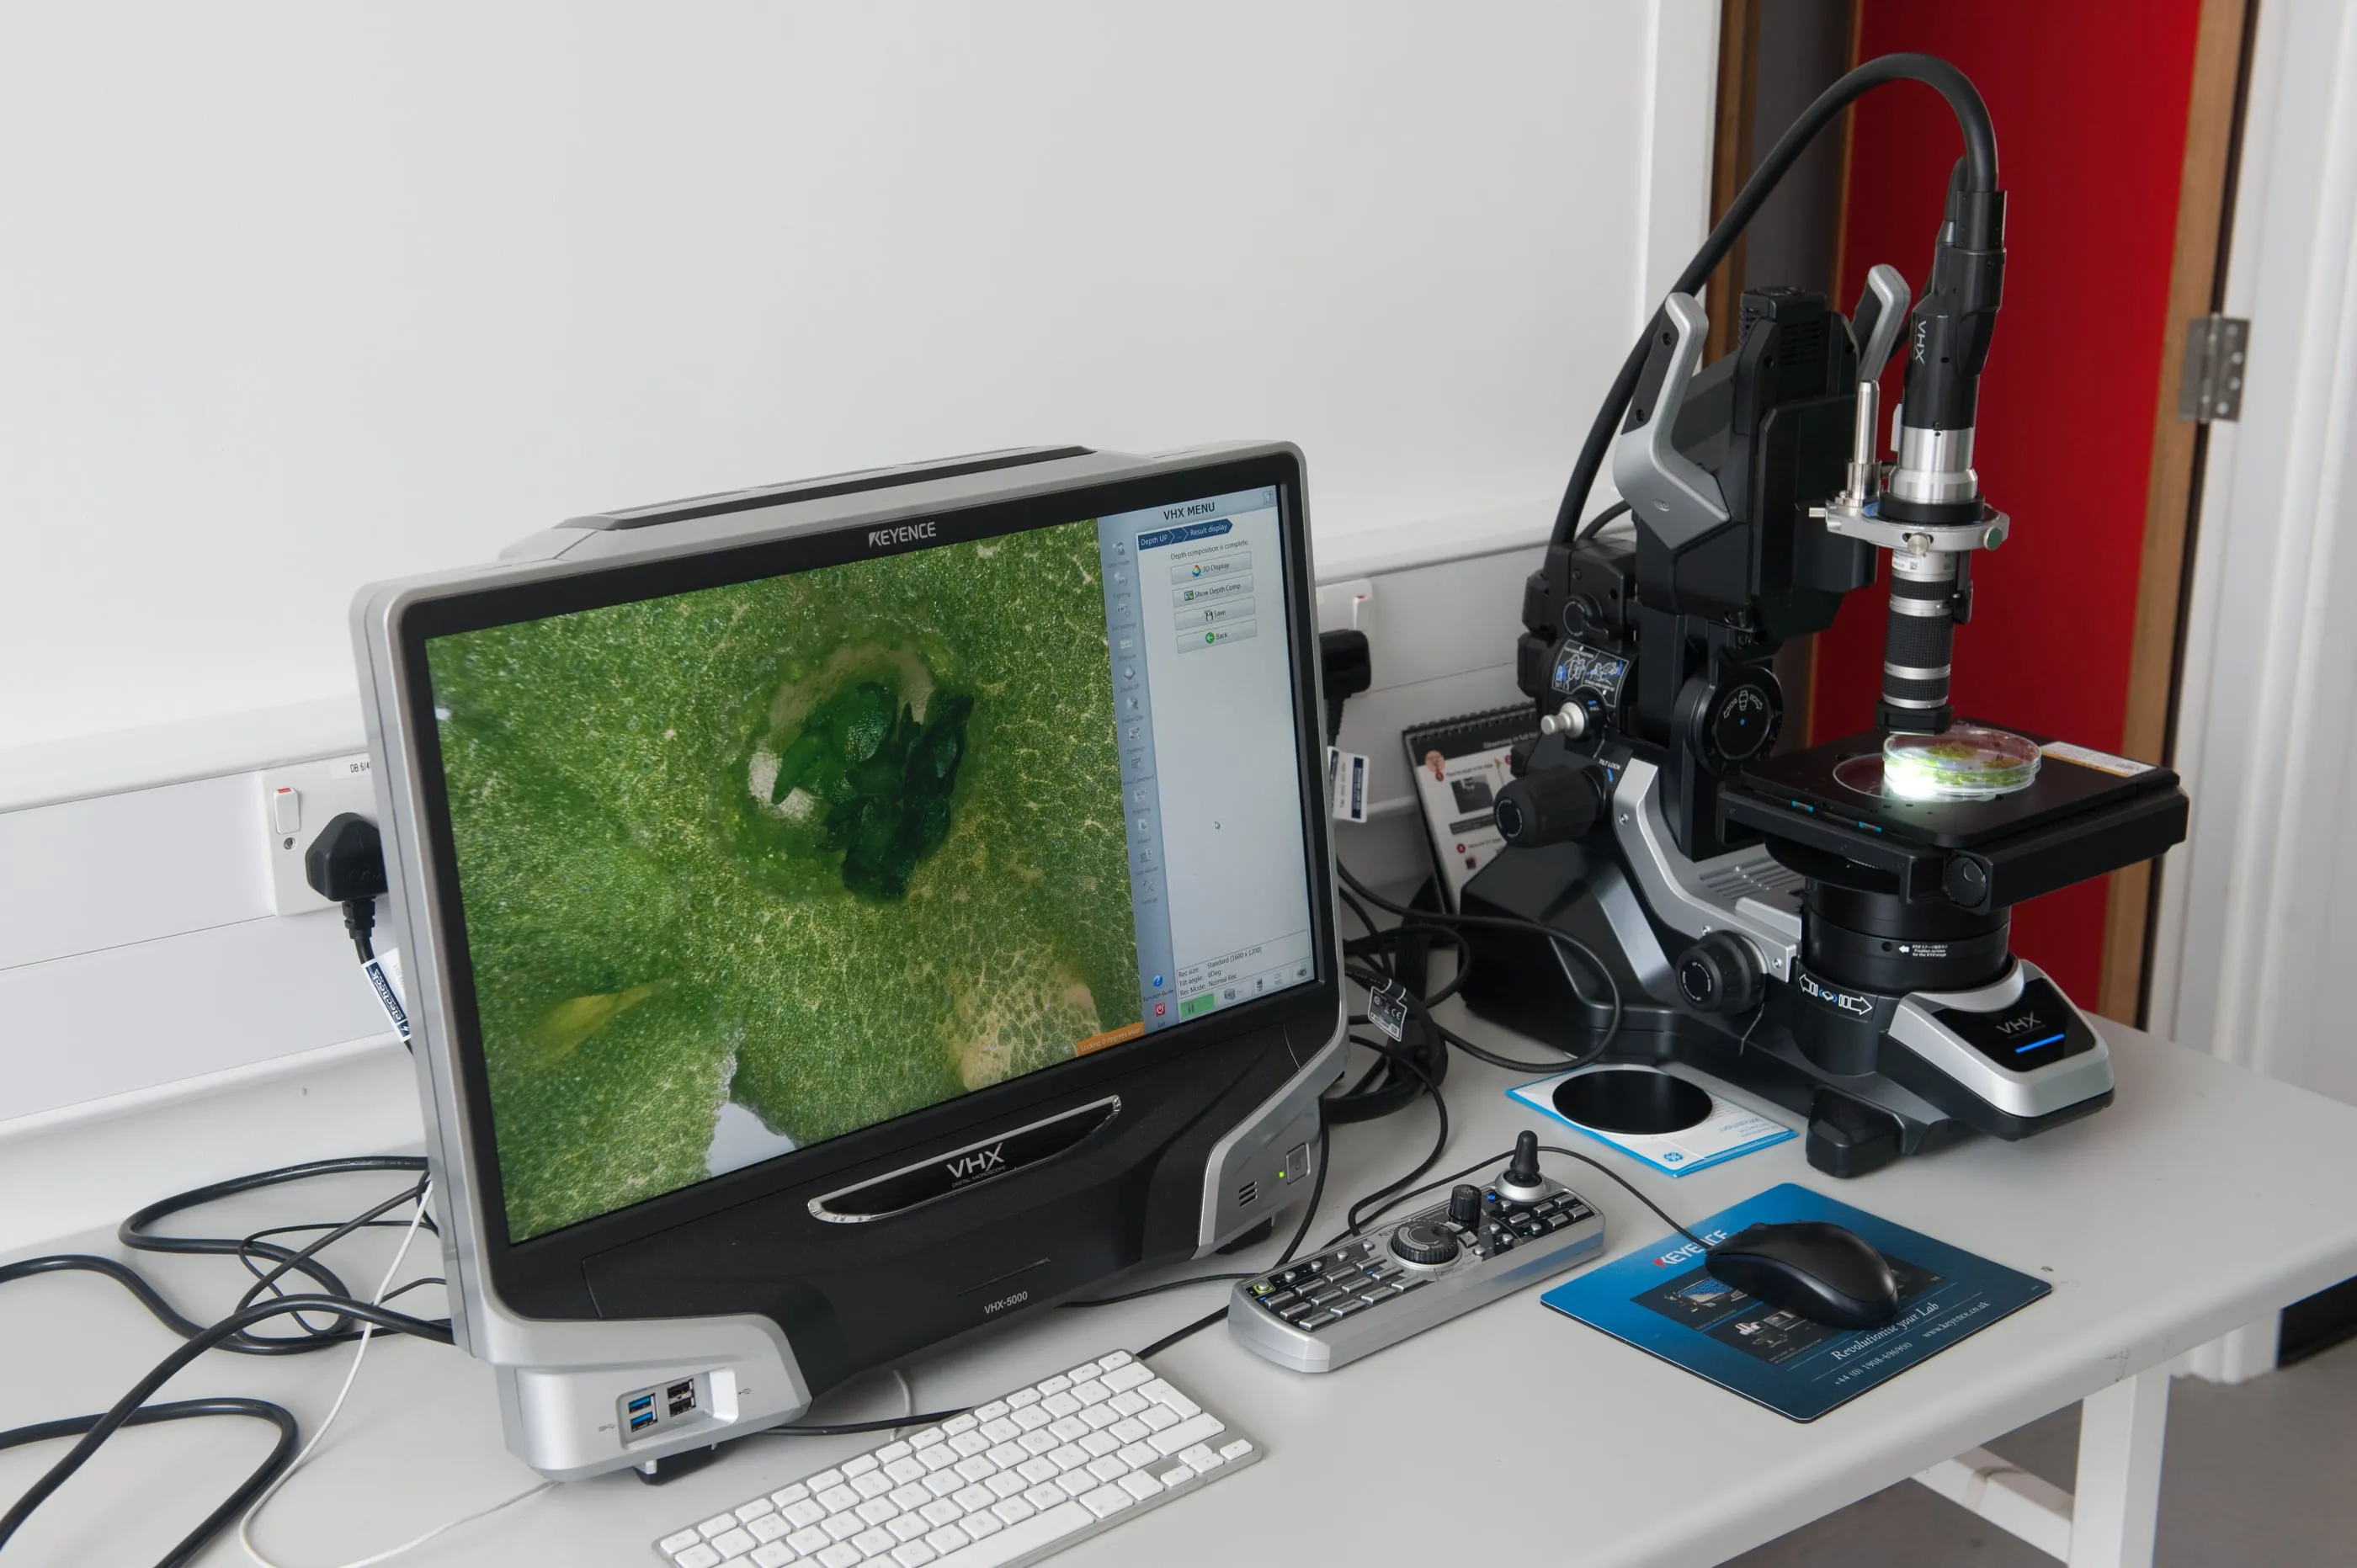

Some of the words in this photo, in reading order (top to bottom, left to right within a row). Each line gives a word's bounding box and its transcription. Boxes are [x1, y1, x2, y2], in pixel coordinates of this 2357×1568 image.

[1914, 321, 1926, 365] VHX
[1163, 508, 1184, 520] VHX
[1187, 502, 1216, 517] MENU
[868, 522, 937, 547] KEYENCE
[1190, 527, 1208, 536] Result
[1209, 523, 1227, 534] display
[1141, 537, 1158, 546] Depth
[1159, 534, 1168, 543] UP
[1170, 551, 1187, 561] Depth
[1187, 544, 1219, 556] composition
[1210, 562, 1230, 571] Display
[1195, 590, 1209, 598] Show
[1209, 587, 1226, 595] Depth
[1226, 583, 1241, 592] Comp
[1214, 609, 1226, 618] Save
[1216, 631, 1228, 640] Back
[350, 763, 359, 773] DB
[1608, 761, 1621, 770] LOCK
[1206, 956, 1229, 969] Standard
[1179, 979, 1188, 987] Tilt
[1180, 989, 1189, 997] Rec
[1208, 976, 1227, 987] Normal
[1227, 973, 1237, 981] Rec
[372, 969, 402, 1020] elecheck
[1995, 1011, 2042, 1034] VHX
[946, 1142, 1005, 1178] VHX
[984, 1290, 1028, 1315] VHX-5000
[1921, 1300, 1993, 1338] www.keyence.co.uk
[1831, 1325, 1898, 1361] Revolutionise
[1897, 1312, 1919, 1331] your
[1915, 1301, 1939, 1317] Lab
[1834, 1374, 1851, 1385] +44
[1849, 1367, 1865, 1379] (0)
[1861, 1340, 1913, 1370] 1908-696900
